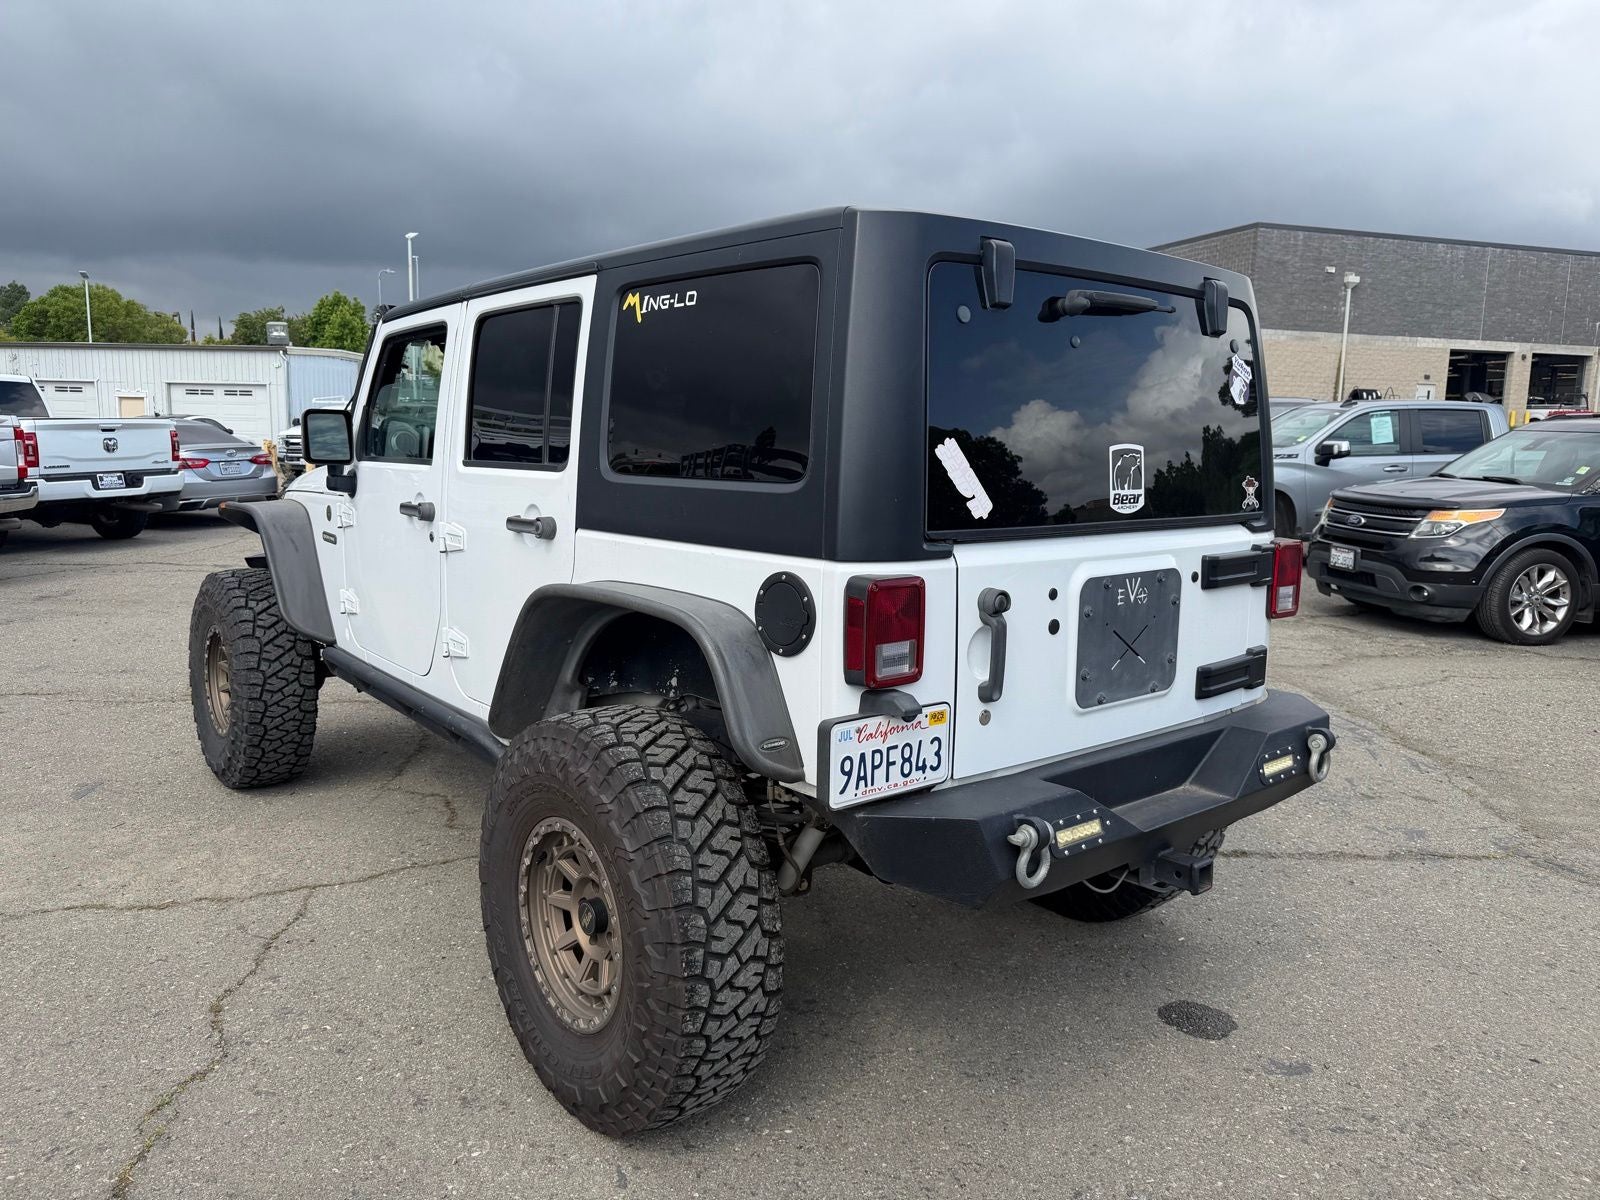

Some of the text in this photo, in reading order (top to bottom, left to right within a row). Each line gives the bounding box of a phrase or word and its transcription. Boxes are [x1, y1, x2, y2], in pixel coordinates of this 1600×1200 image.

[1113, 493, 1142, 505] Bear
[838, 720, 928, 743] JUL California
[839, 736, 942, 795] 9APF843
[861, 776, 921, 796] dmv.ca.gov
